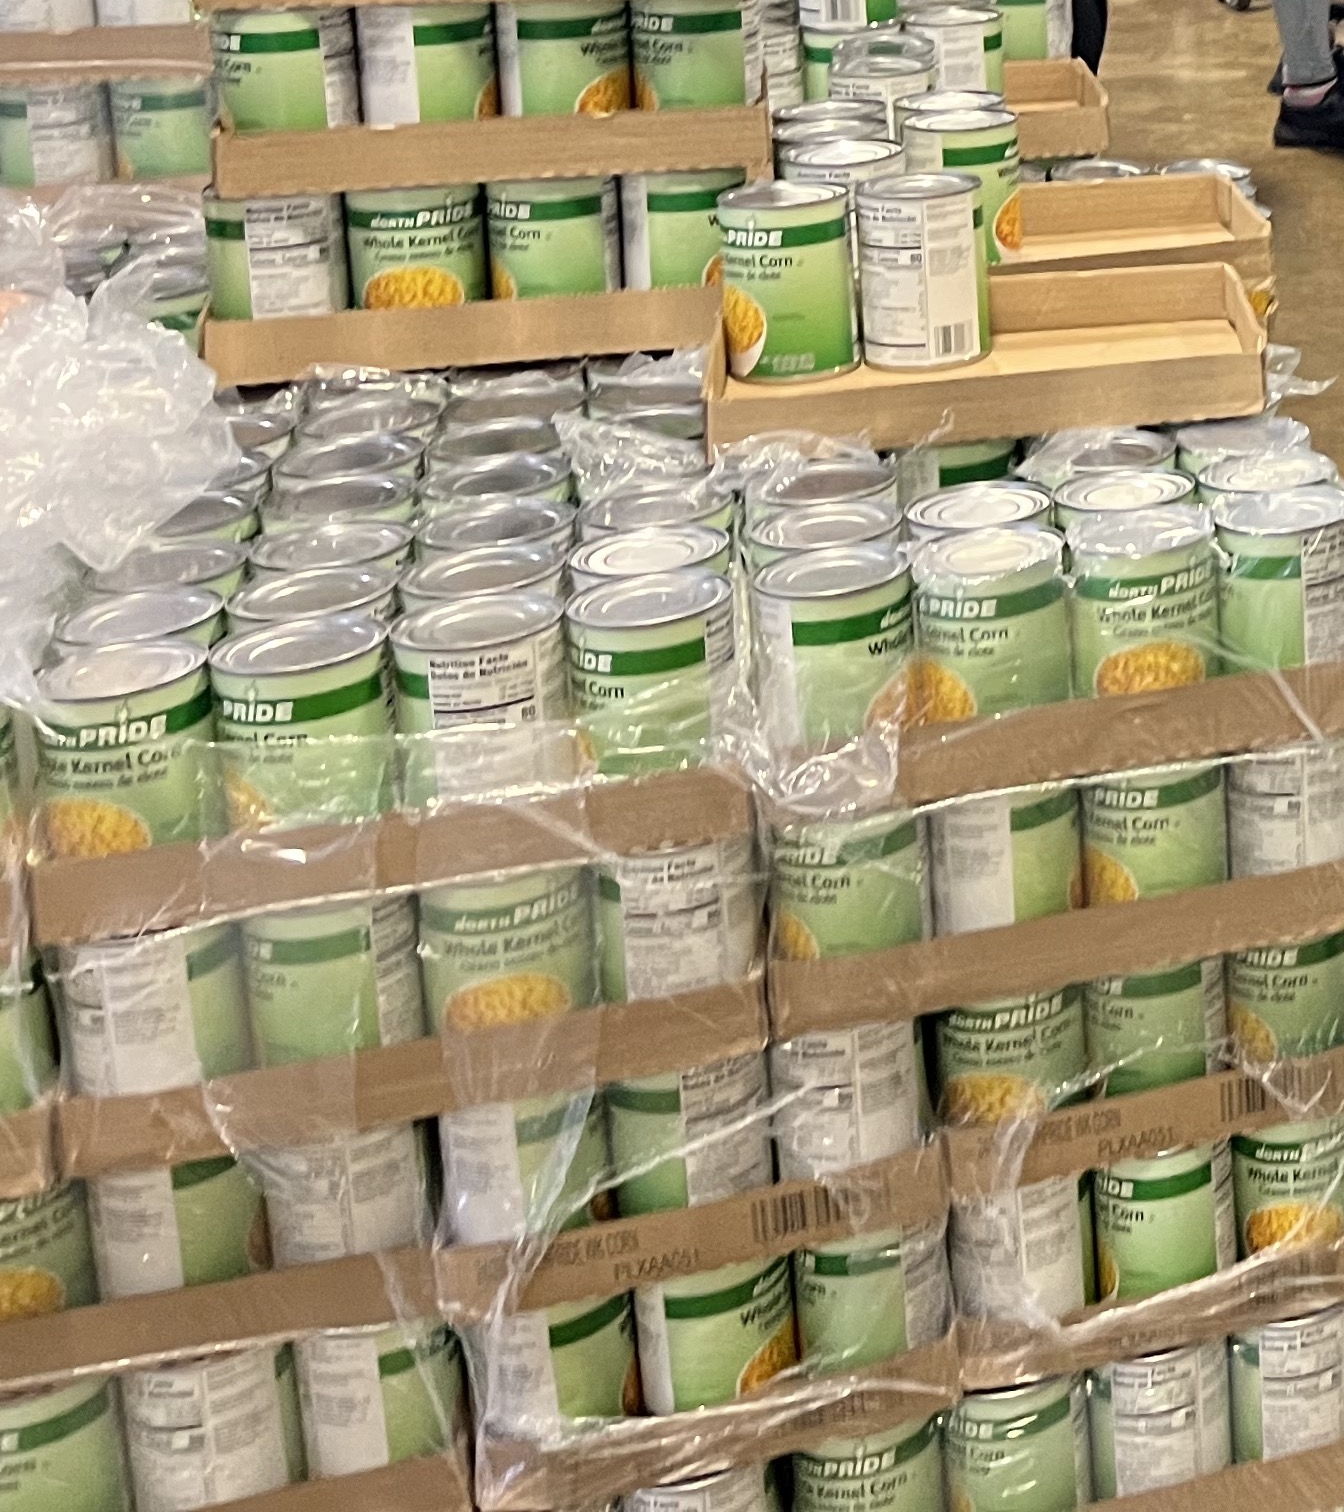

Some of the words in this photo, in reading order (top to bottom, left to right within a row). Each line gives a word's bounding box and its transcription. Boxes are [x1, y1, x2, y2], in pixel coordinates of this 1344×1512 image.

[371, 204, 414, 228] NORTH
[408, 226, 455, 249] Kernel
[509, 229, 541, 240] Corn
[727, 218, 783, 247] PRIDE
[759, 253, 793, 268] Corn
[929, 588, 998, 619] PRIDE
[1151, 595, 1198, 620] Kernel
[969, 627, 1009, 643] Corn
[588, 680, 625, 699] Corn
[222, 688, 294, 723] PRIDE
[80, 709, 167, 749] PRIDE
[71, 751, 132, 775] Kernel
[1094, 785, 1159, 809] PRIDE
[1131, 816, 1169, 831] Corn
[811, 872, 851, 889] Corn
[1271, 974, 1308, 989] Corn
[995, 995, 1064, 1029] PRIDE
[824, 1448, 896, 1478] PRIDE
[870, 1472, 908, 1495] Corn
